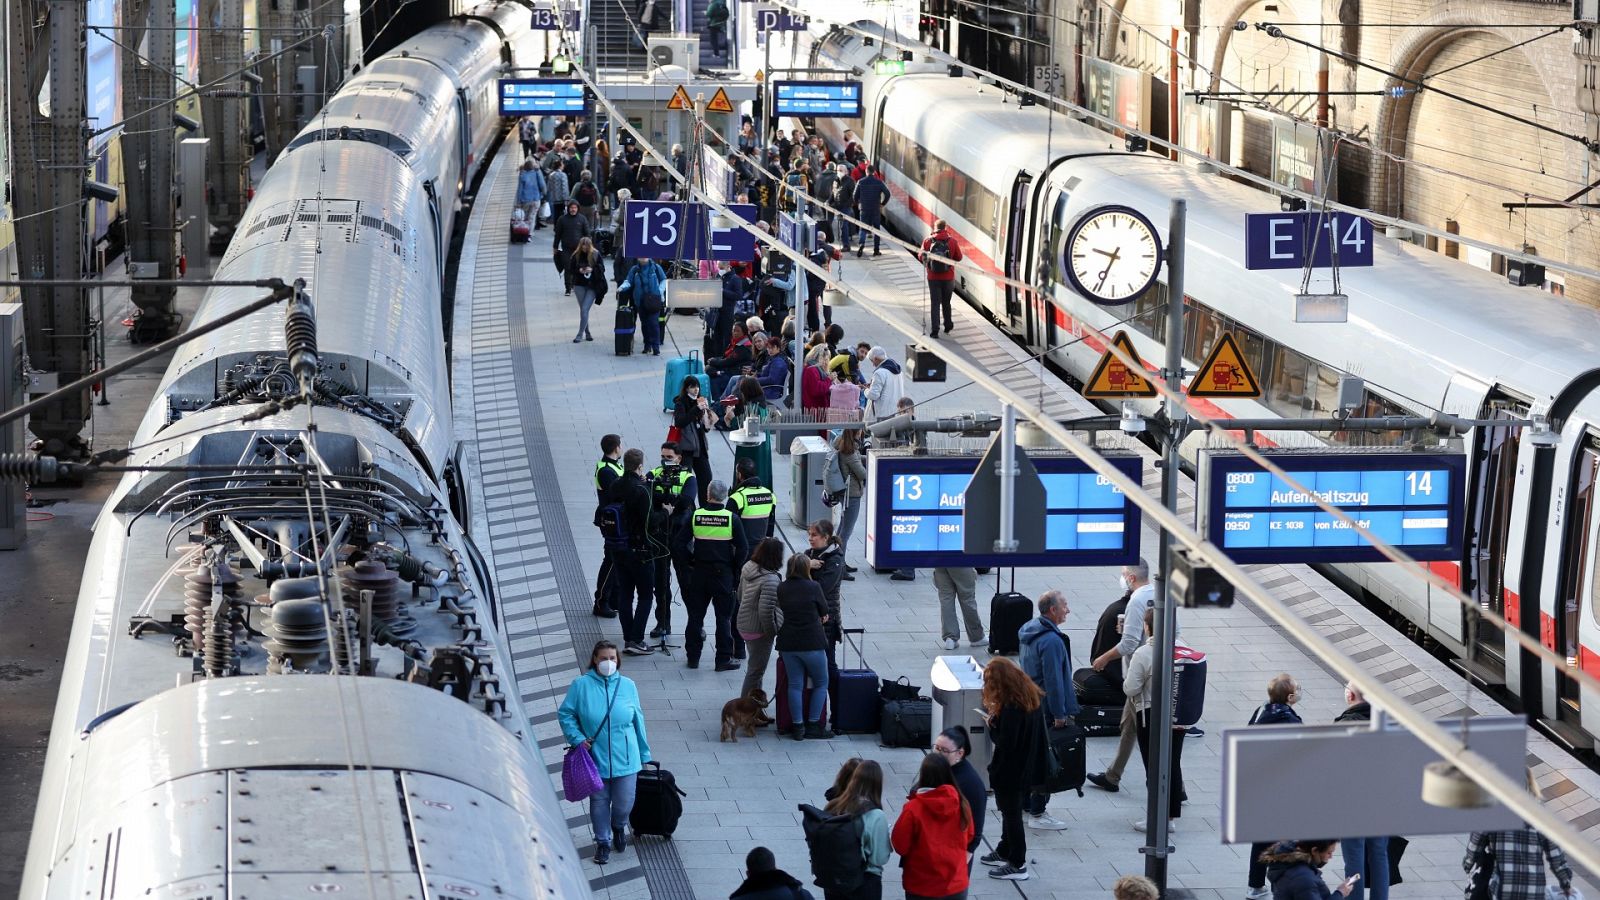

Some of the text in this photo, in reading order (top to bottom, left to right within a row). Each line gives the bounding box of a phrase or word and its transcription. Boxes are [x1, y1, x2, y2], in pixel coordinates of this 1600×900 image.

[532, 10, 551, 26] 13
[764, 11, 777, 28] D
[1036, 67, 1060, 80] 355
[634, 207, 678, 246] 13
[1269, 216, 1366, 260] E 14
[1226, 473, 1255, 484] 08:00
[1406, 470, 1433, 496] 14
[894, 475, 923, 500] 13
[1270, 490, 1369, 506] Aufenthaltszug
[892, 524, 960, 534] 09:37 RB41
[1224, 521, 1251, 531] 09:50
[1269, 521, 1283, 530] ICE
[1314, 522, 1330, 530] von
